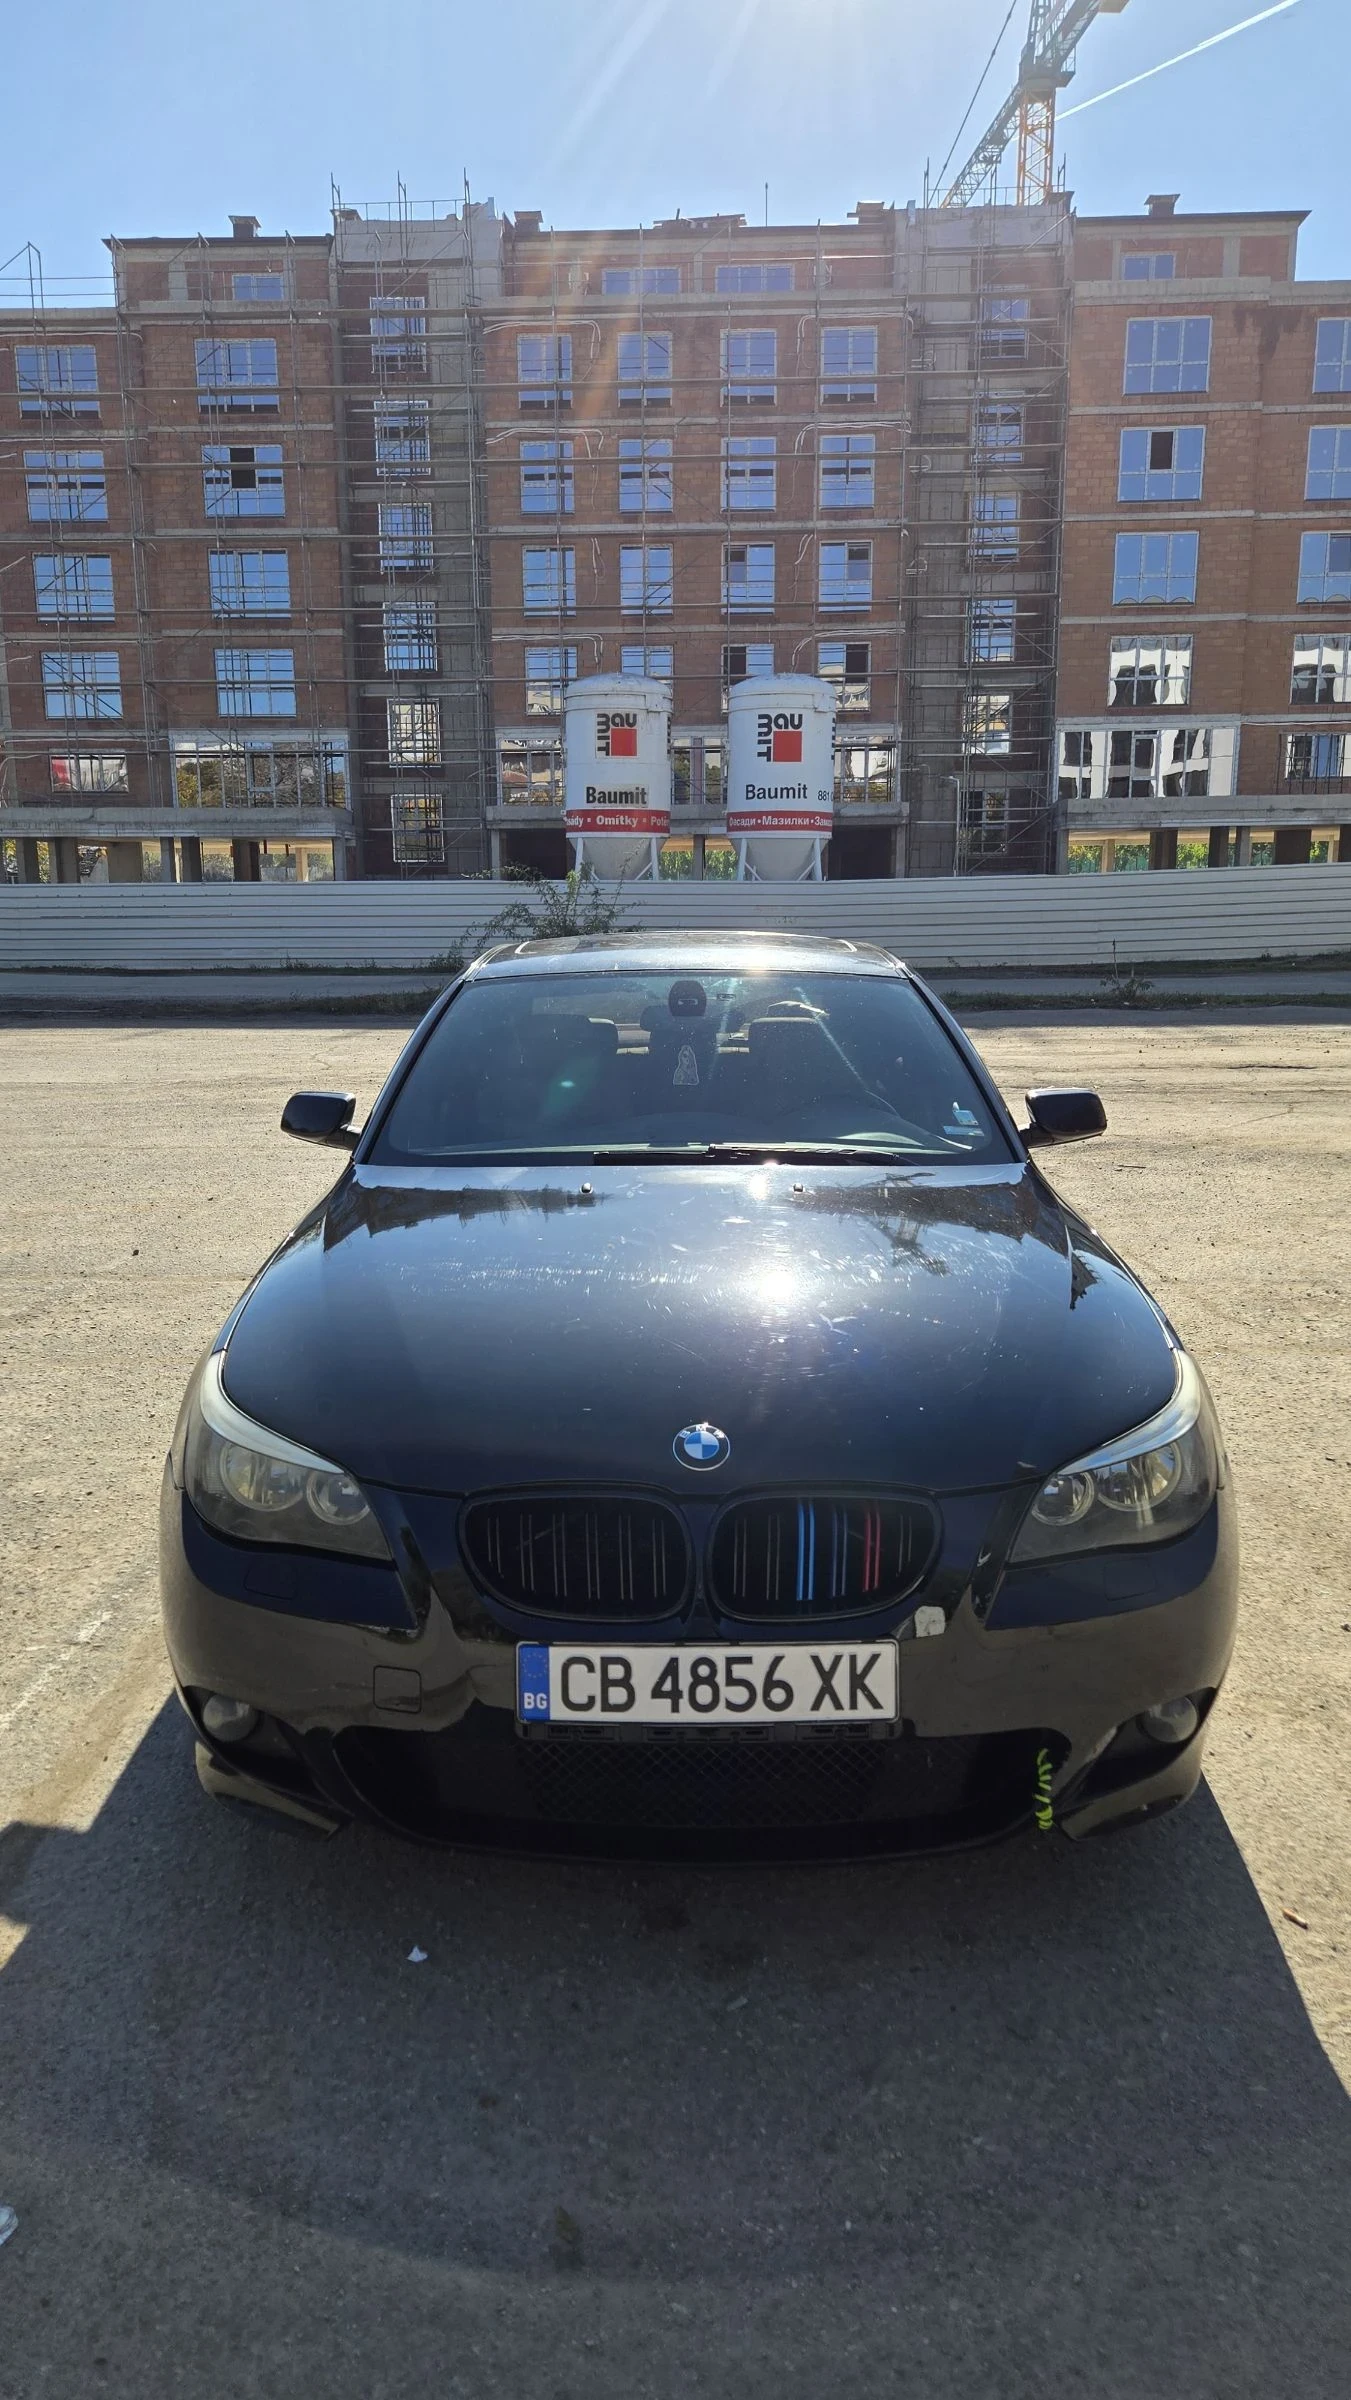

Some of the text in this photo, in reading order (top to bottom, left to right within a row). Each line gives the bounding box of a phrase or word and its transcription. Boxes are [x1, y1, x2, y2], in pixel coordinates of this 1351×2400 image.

[585, 786, 647, 805] Baumit
[745, 783, 808, 801] Baumit
[596, 814, 639, 828] Omítky
[762, 815, 809, 826] Мазилки
[560, 1653, 884, 1714] CB 4856 XK
[523, 1692, 548, 1710] BG
